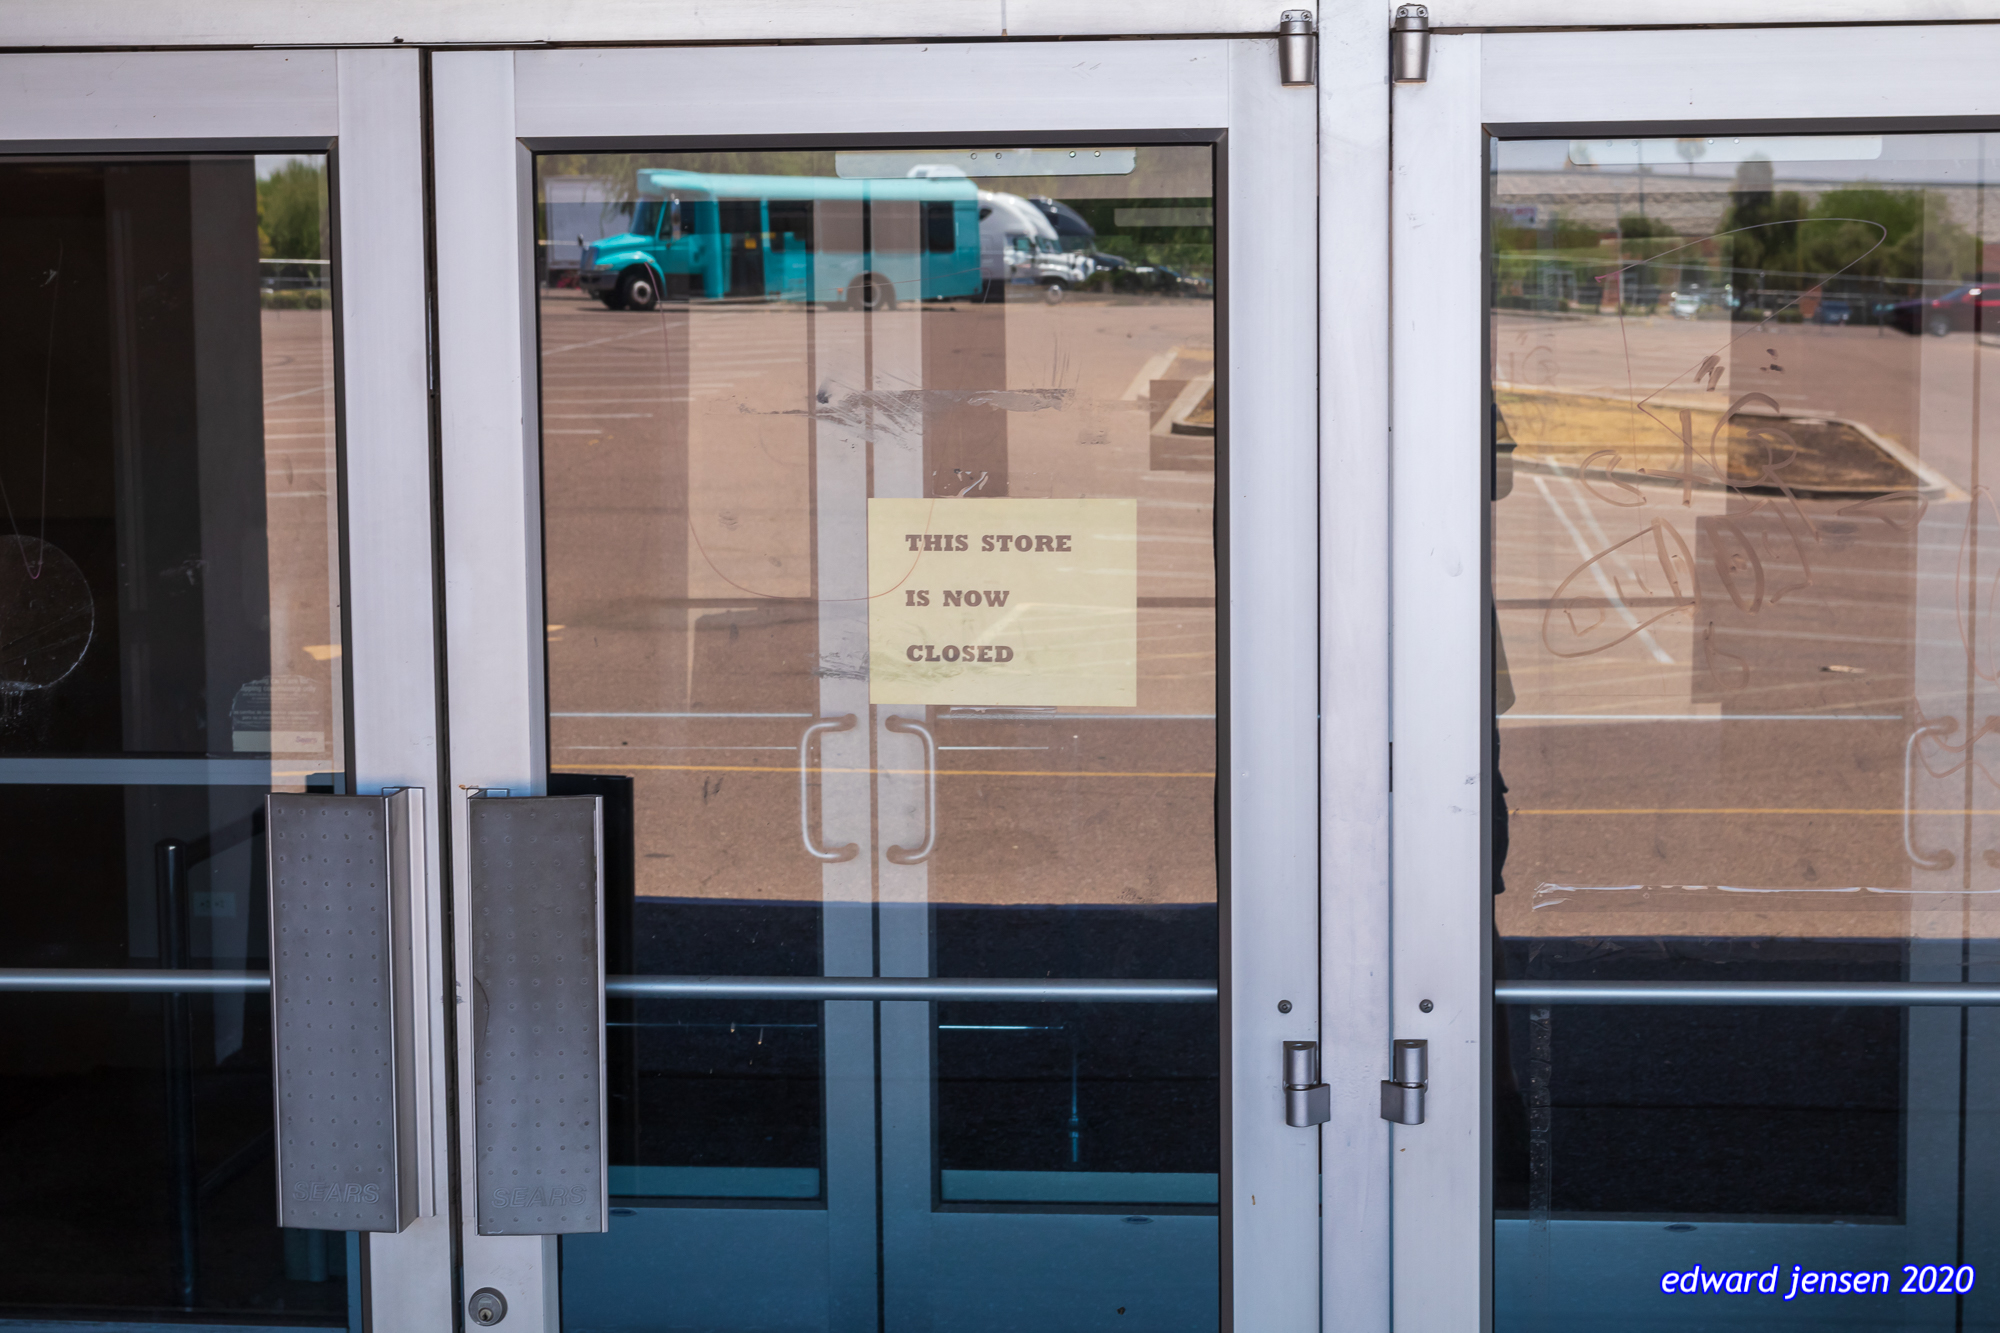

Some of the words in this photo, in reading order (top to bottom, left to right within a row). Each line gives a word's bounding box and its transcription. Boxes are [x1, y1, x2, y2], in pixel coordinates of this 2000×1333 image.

[905, 534, 969, 552] THIS
[981, 535, 1072, 552] STORE
[905, 590, 930, 607] IS
[943, 590, 1010, 607] NOW
[906, 645, 1014, 662] CLOSED
[292, 1181, 380, 1204] SEARS
[492, 1184, 588, 1208] SEARS
